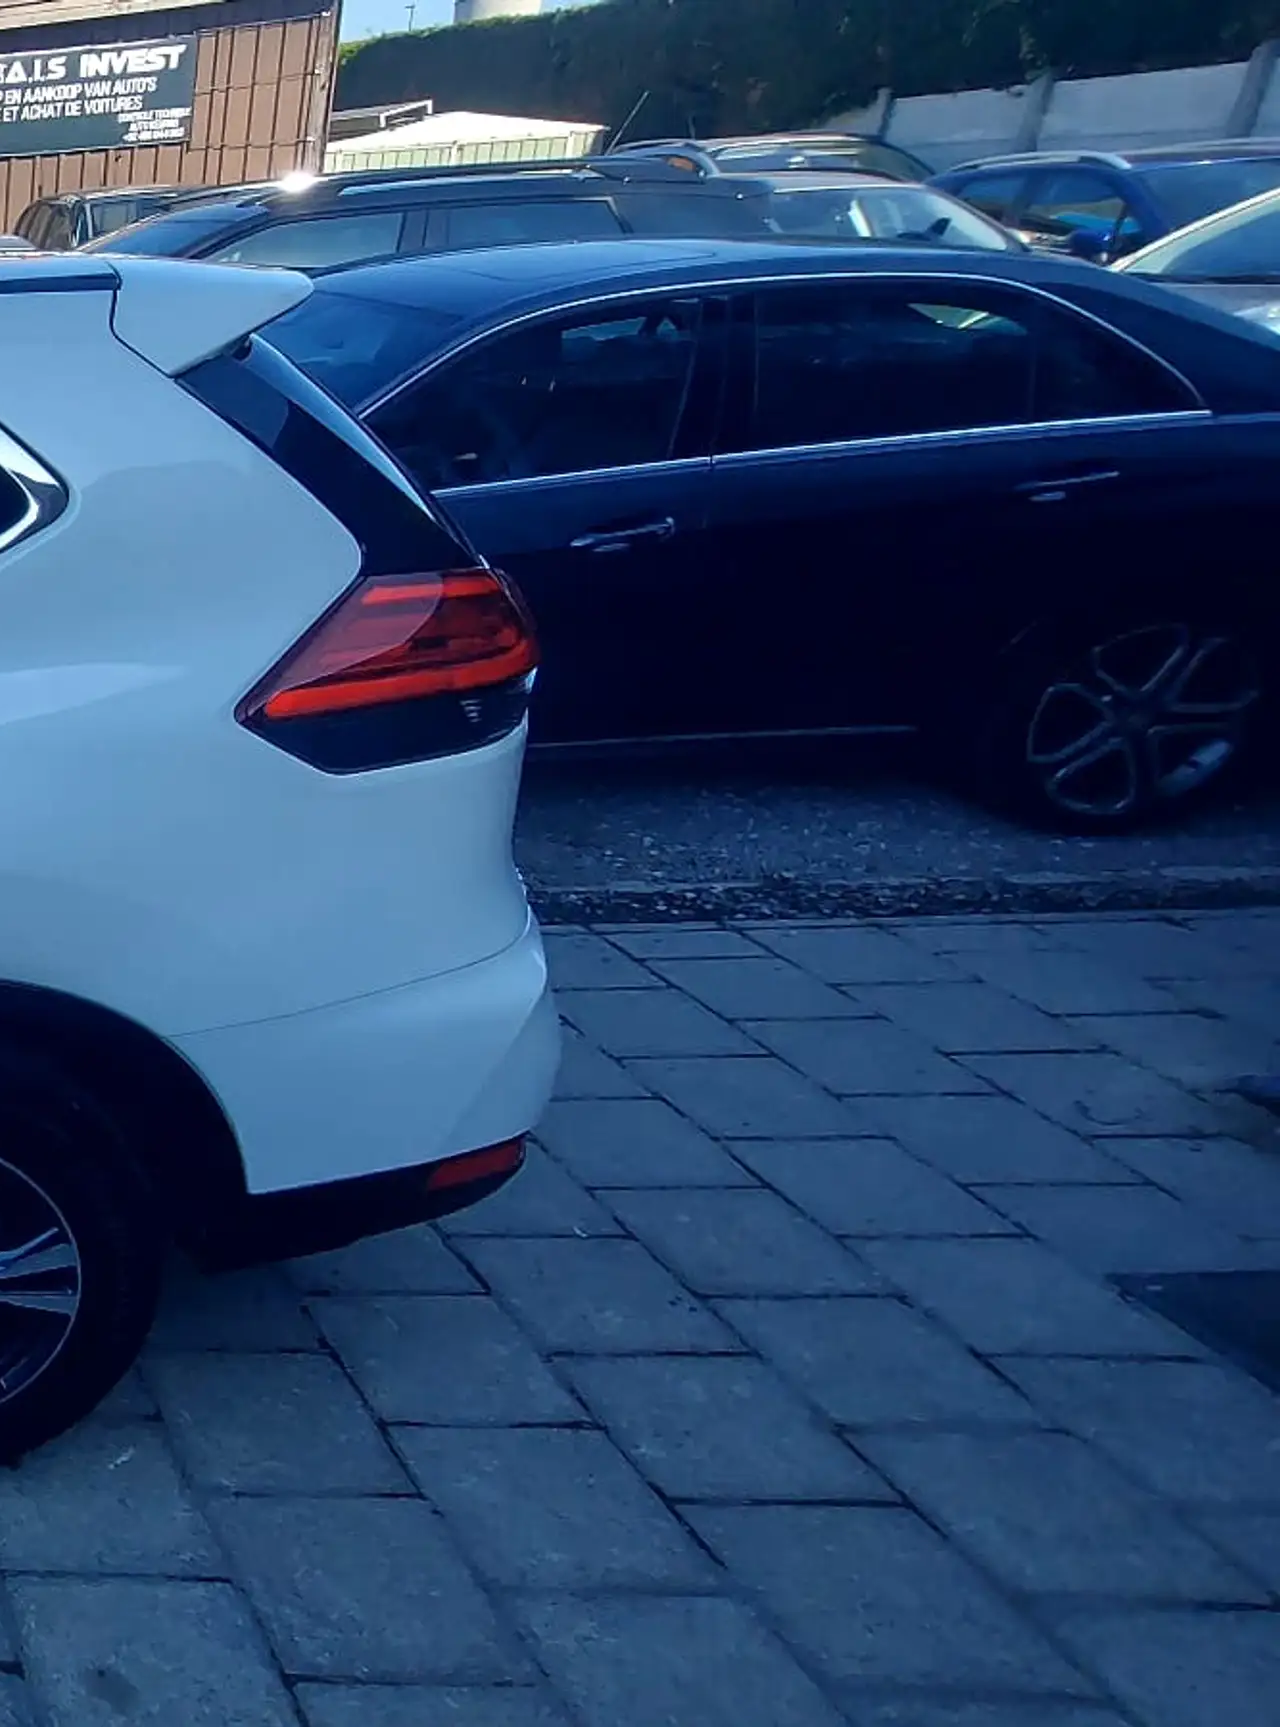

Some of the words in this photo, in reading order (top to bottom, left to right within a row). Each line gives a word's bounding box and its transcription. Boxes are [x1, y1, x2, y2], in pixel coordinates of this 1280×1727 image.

[80, 44, 188, 78] INVEST
[5, 88, 23, 107] EN
[23, 82, 83, 104] AANKOOP
[83, 80, 114, 99] VAN
[3, 105, 19, 122] ET
[21, 101, 64, 121] ACHAT
[64, 99, 83, 117] DE
[83, 95, 144, 115] VOITURES
